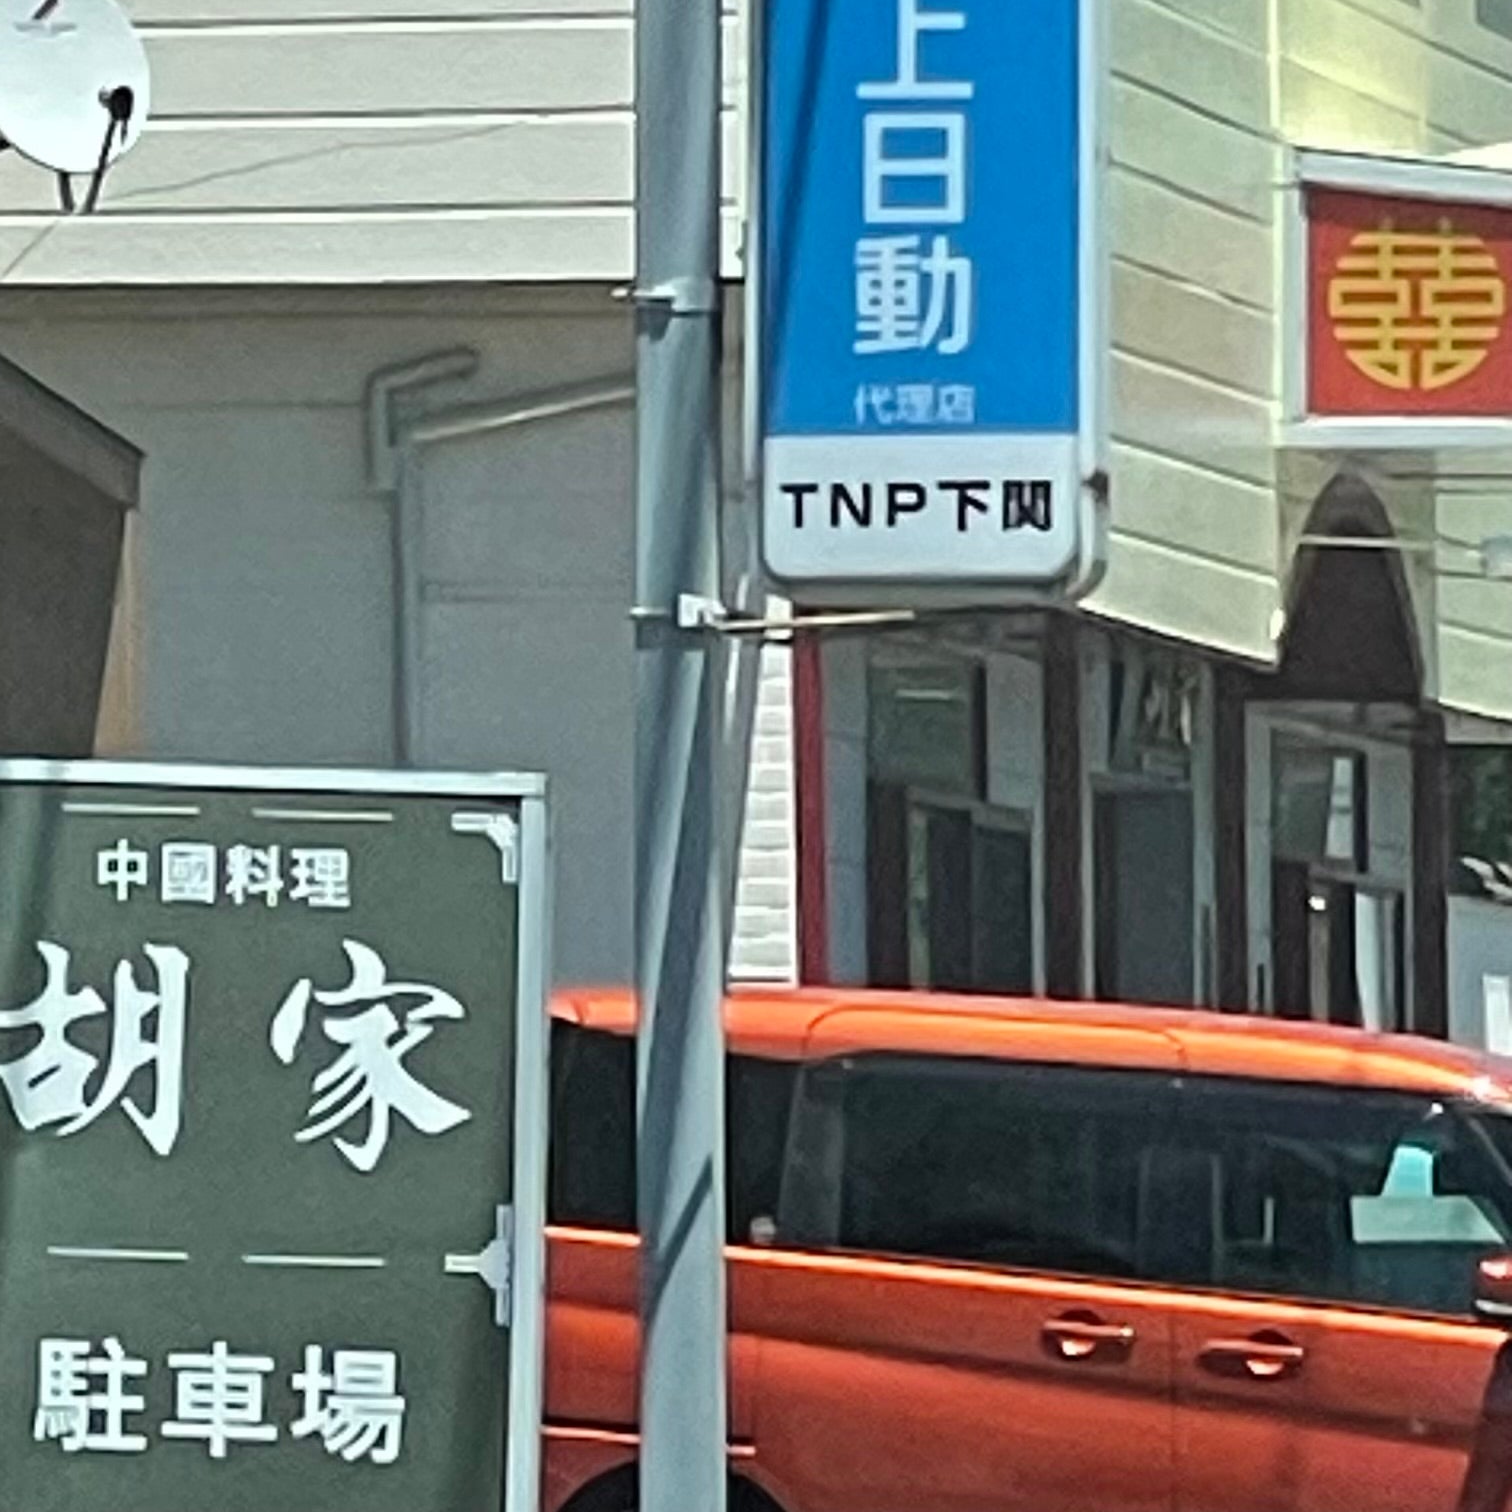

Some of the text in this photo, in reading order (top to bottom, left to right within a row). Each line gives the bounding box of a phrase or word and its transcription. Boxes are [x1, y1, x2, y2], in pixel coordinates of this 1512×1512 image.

[854, 383, 976, 426] 代理店
[779, 480, 1053, 532] TNP下関
[97, 838, 352, 908] 中國料理
[34, 1336, 406, 1464] 駐車場
